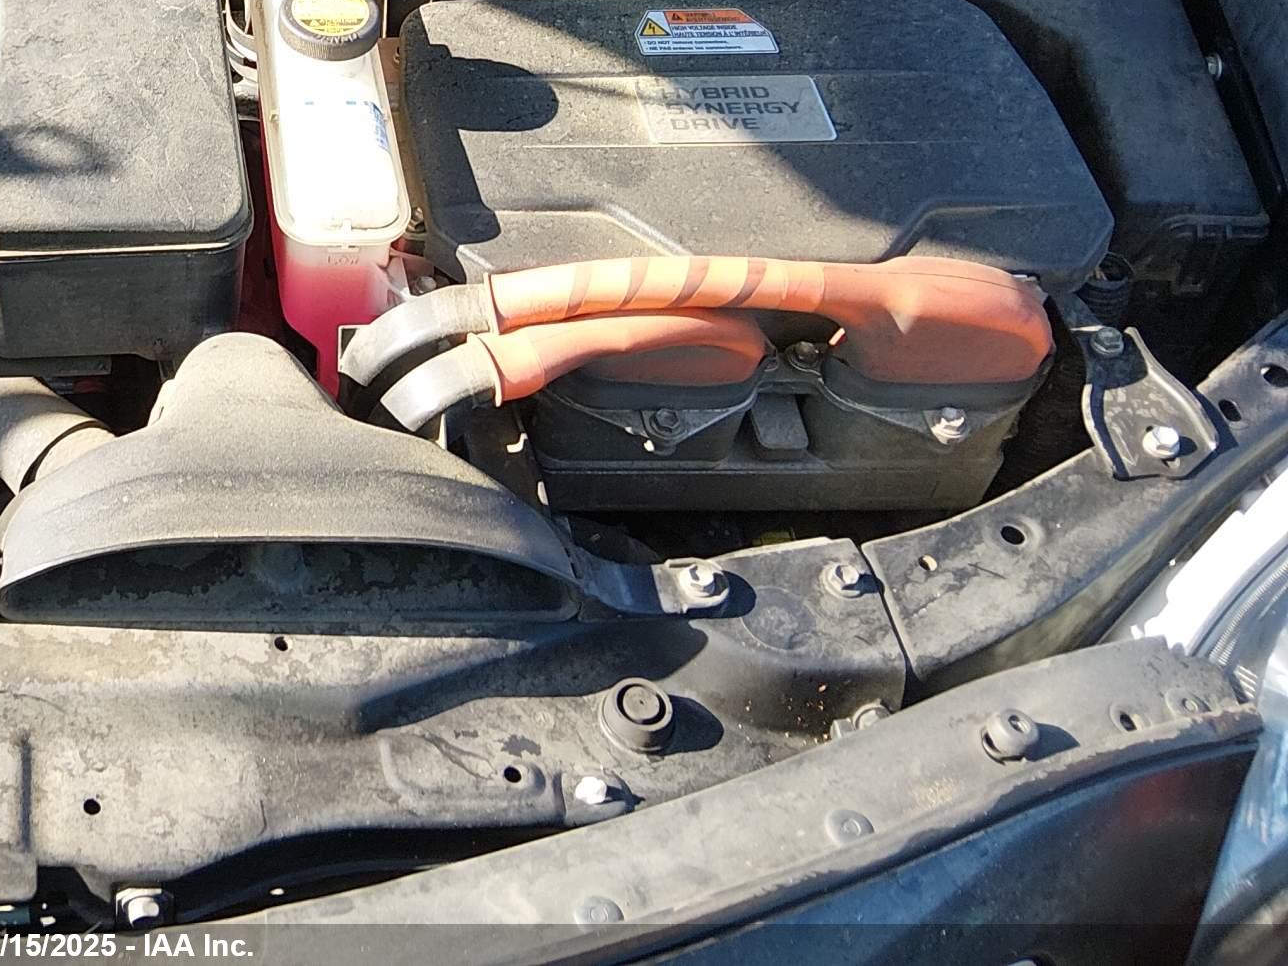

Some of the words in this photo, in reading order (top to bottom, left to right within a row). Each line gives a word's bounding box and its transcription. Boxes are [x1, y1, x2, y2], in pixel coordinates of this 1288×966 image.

[662, 86, 770, 99] HYBRID
[665, 102, 801, 115] SYNERGY
[670, 117, 762, 131] DRIVE
